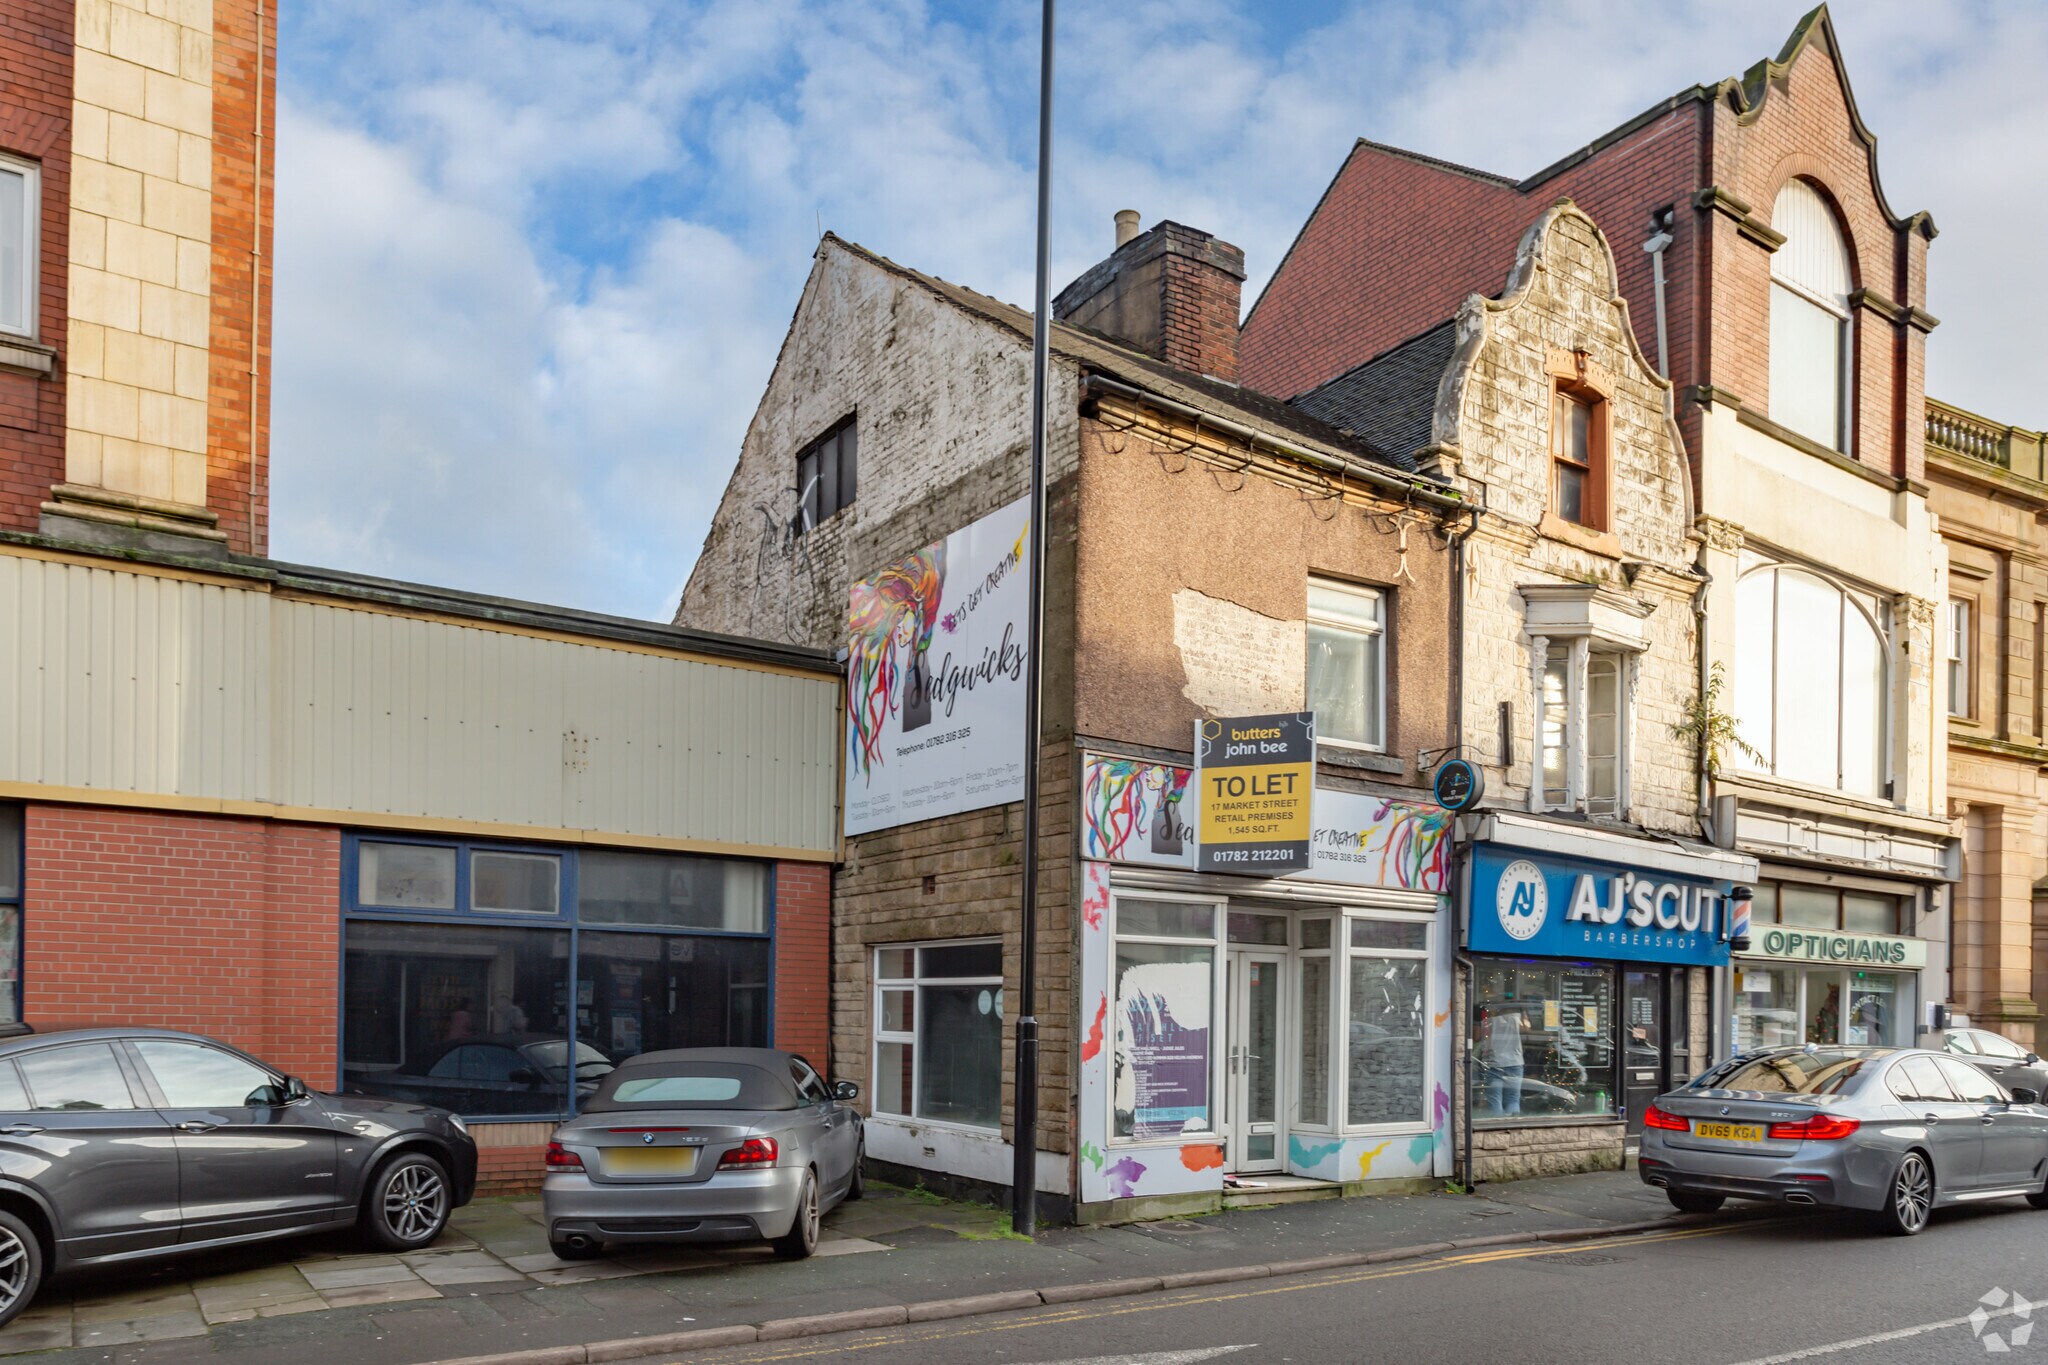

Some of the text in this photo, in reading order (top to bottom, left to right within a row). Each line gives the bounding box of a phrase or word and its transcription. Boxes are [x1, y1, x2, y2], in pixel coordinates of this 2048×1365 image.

[967, 581, 985, 612] GET
[986, 542, 1020, 594] CREATIVE
[909, 622, 1028, 718] Sedgwicks
[896, 727, 971, 757] Telephone: 01782 316 325
[1231, 728, 1281, 741] butters
[1224, 741, 1288, 759] john bee
[1212, 773, 1299, 798] TO LET
[1211, 799, 1299, 811] 17 MARKET STREET
[1215, 812, 1294, 823] RETAIL PREMISES
[1228, 824, 1280, 835] 1,545 SQ.FT.
[1313, 829, 1368, 850] ET CREATIVE
[1213, 849, 1294, 862] 01782 212201
[1340, 852, 1352, 862] 316
[1352, 854, 1367, 864] 325
[1583, 930, 1696, 949] BARBERSHOP
[1764, 930, 1906, 964] OPTICIANS
[1150, 1033, 1174, 1043] SET
[1700, 1124, 1757, 1139] DV69 KGA
